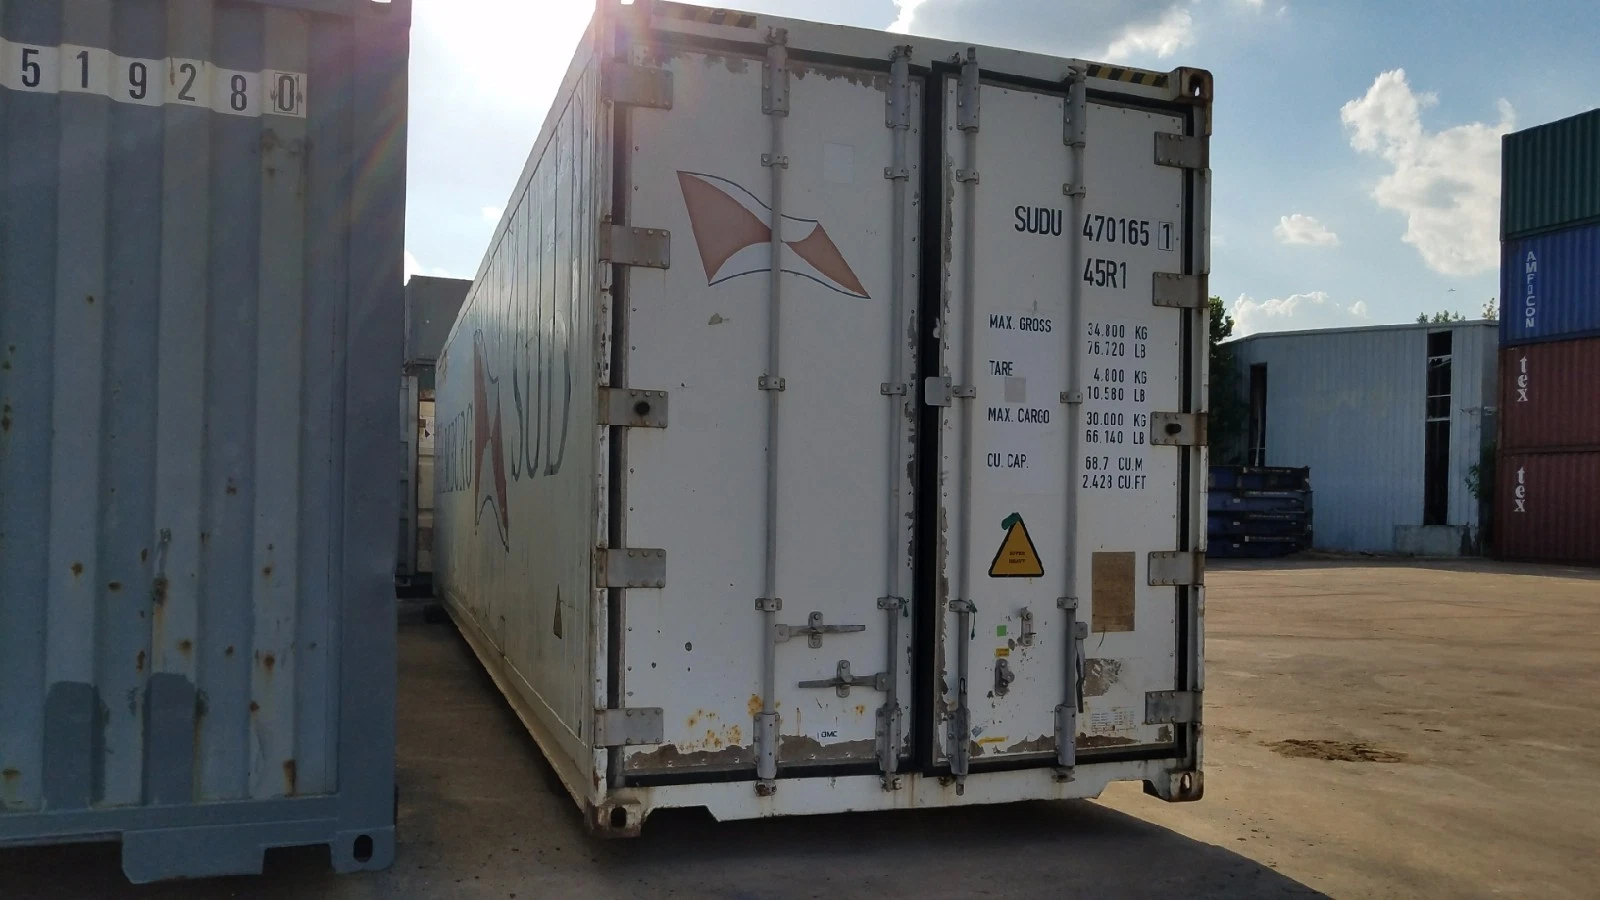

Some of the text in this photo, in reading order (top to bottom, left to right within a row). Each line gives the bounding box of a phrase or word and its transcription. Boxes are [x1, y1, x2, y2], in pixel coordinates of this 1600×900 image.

[1015, 206, 1171, 250] SUDU 470165 1
[1084, 258, 1127, 290] 45R1
[989, 314, 1052, 333] MAX. GROSS
[1088, 323, 1148, 341] 34.800 KG
[1088, 341, 1146, 359] 76.720 LB
[989, 360, 1013, 376] TARE
[1094, 368, 1147, 385] 4.800 KG
[1516, 356, 1528, 402] tex
[1088, 386, 1146, 403] 10.580 LB
[988, 408, 1050, 424] MAX. CARGO
[1087, 412, 1147, 428] 30.000 KG
[1086, 430, 1145, 445] 66.140 LB
[987, 453, 1029, 469] CU. CAP.
[1086, 456, 1143, 472] 68.7 CU.M
[1118, 475, 1147, 490] CU.FT
[1514, 466, 1526, 512] tex
